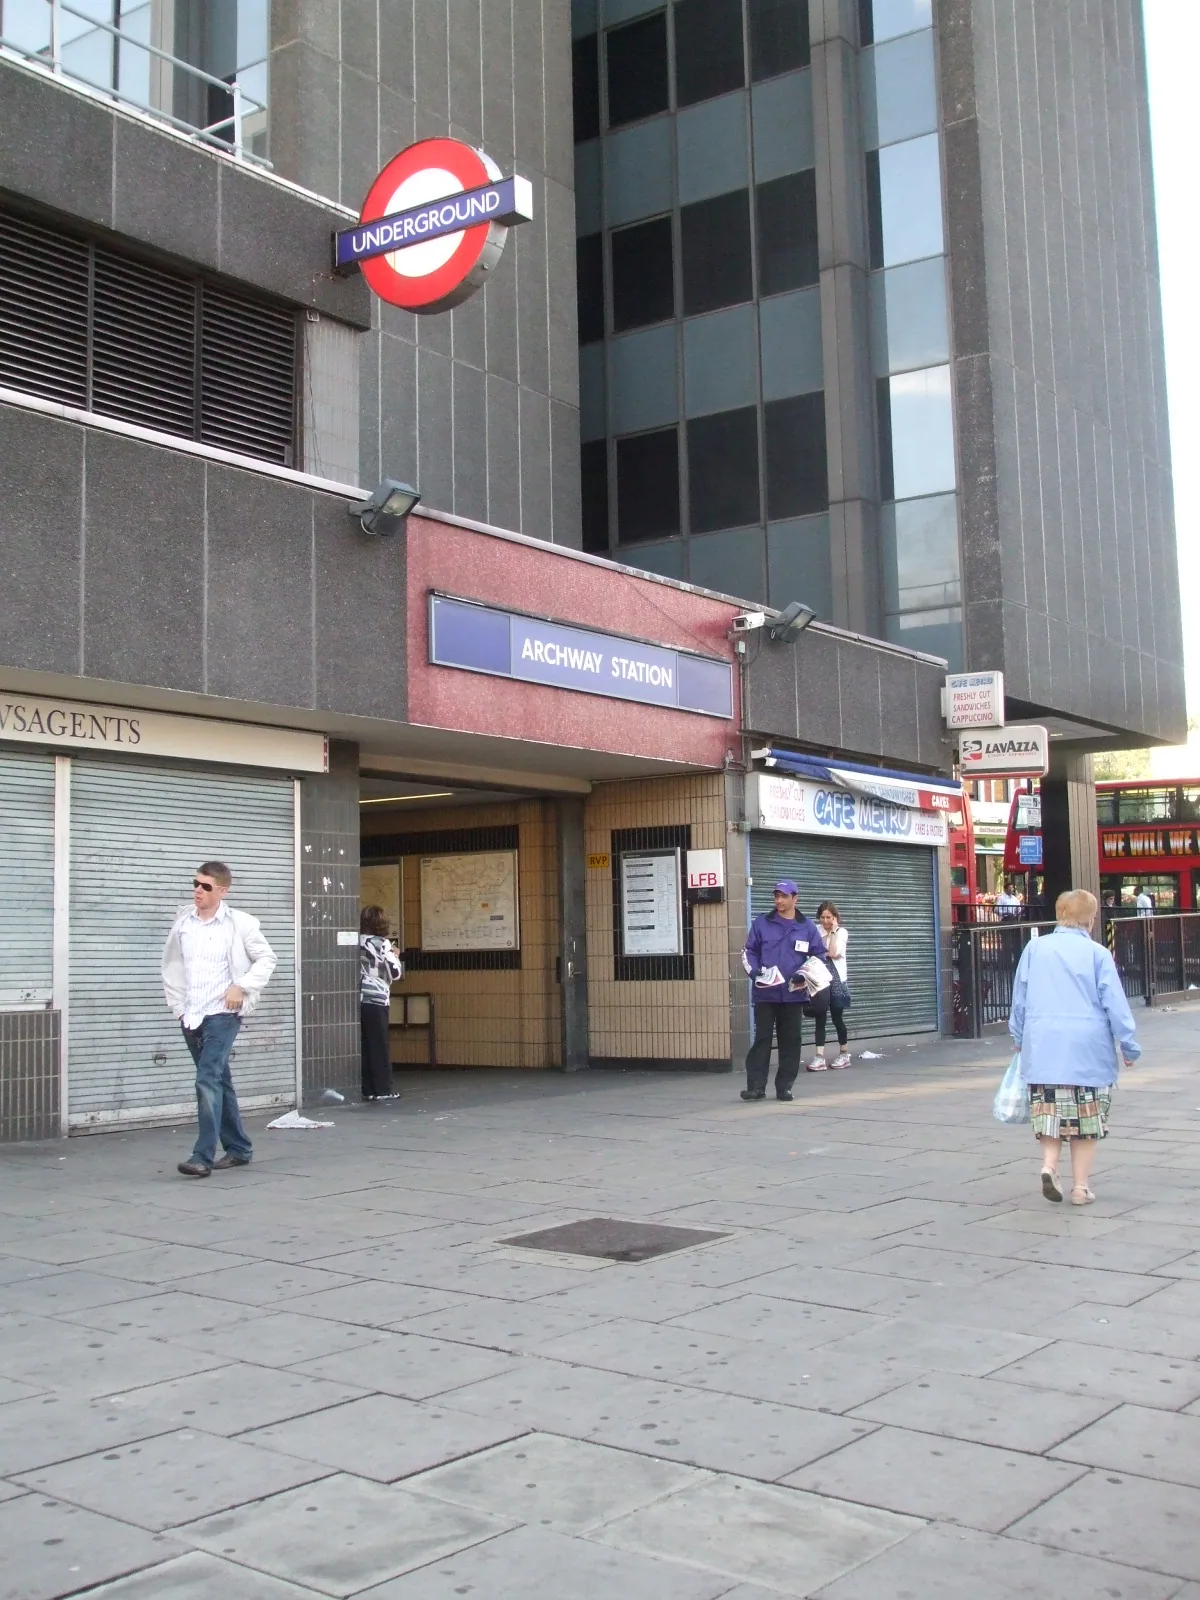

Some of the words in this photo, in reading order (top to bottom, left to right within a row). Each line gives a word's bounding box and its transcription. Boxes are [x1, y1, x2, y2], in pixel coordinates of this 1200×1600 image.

[352, 191, 500, 253] UNDERGROUND
[521, 637, 603, 674] ARCHWAY
[611, 656, 673, 688] STATION
[951, 679, 968, 688] CAFE
[953, 691, 976, 701] FRESHLY
[979, 690, 991, 699] CUT
[953, 701, 991, 713] SANDWICHES
[951, 712, 993, 724] CAPPUCCINO
[985, 740, 1040, 754] LAVAZZA
[769, 784, 792, 801] FRESHLY
[793, 788, 805, 803] CUT
[931, 794, 950, 809] CAKES
[769, 804, 805, 822] SANDWICHES
[813, 789, 856, 830] CAFE
[857, 794, 913, 837] METRO
[1103, 833, 1125, 857] WE
[1128, 831, 1166, 856] WILL
[1168, 830, 1193, 855] WE
[589, 855, 608, 865] RVP
[690, 872, 718, 888] LFB
